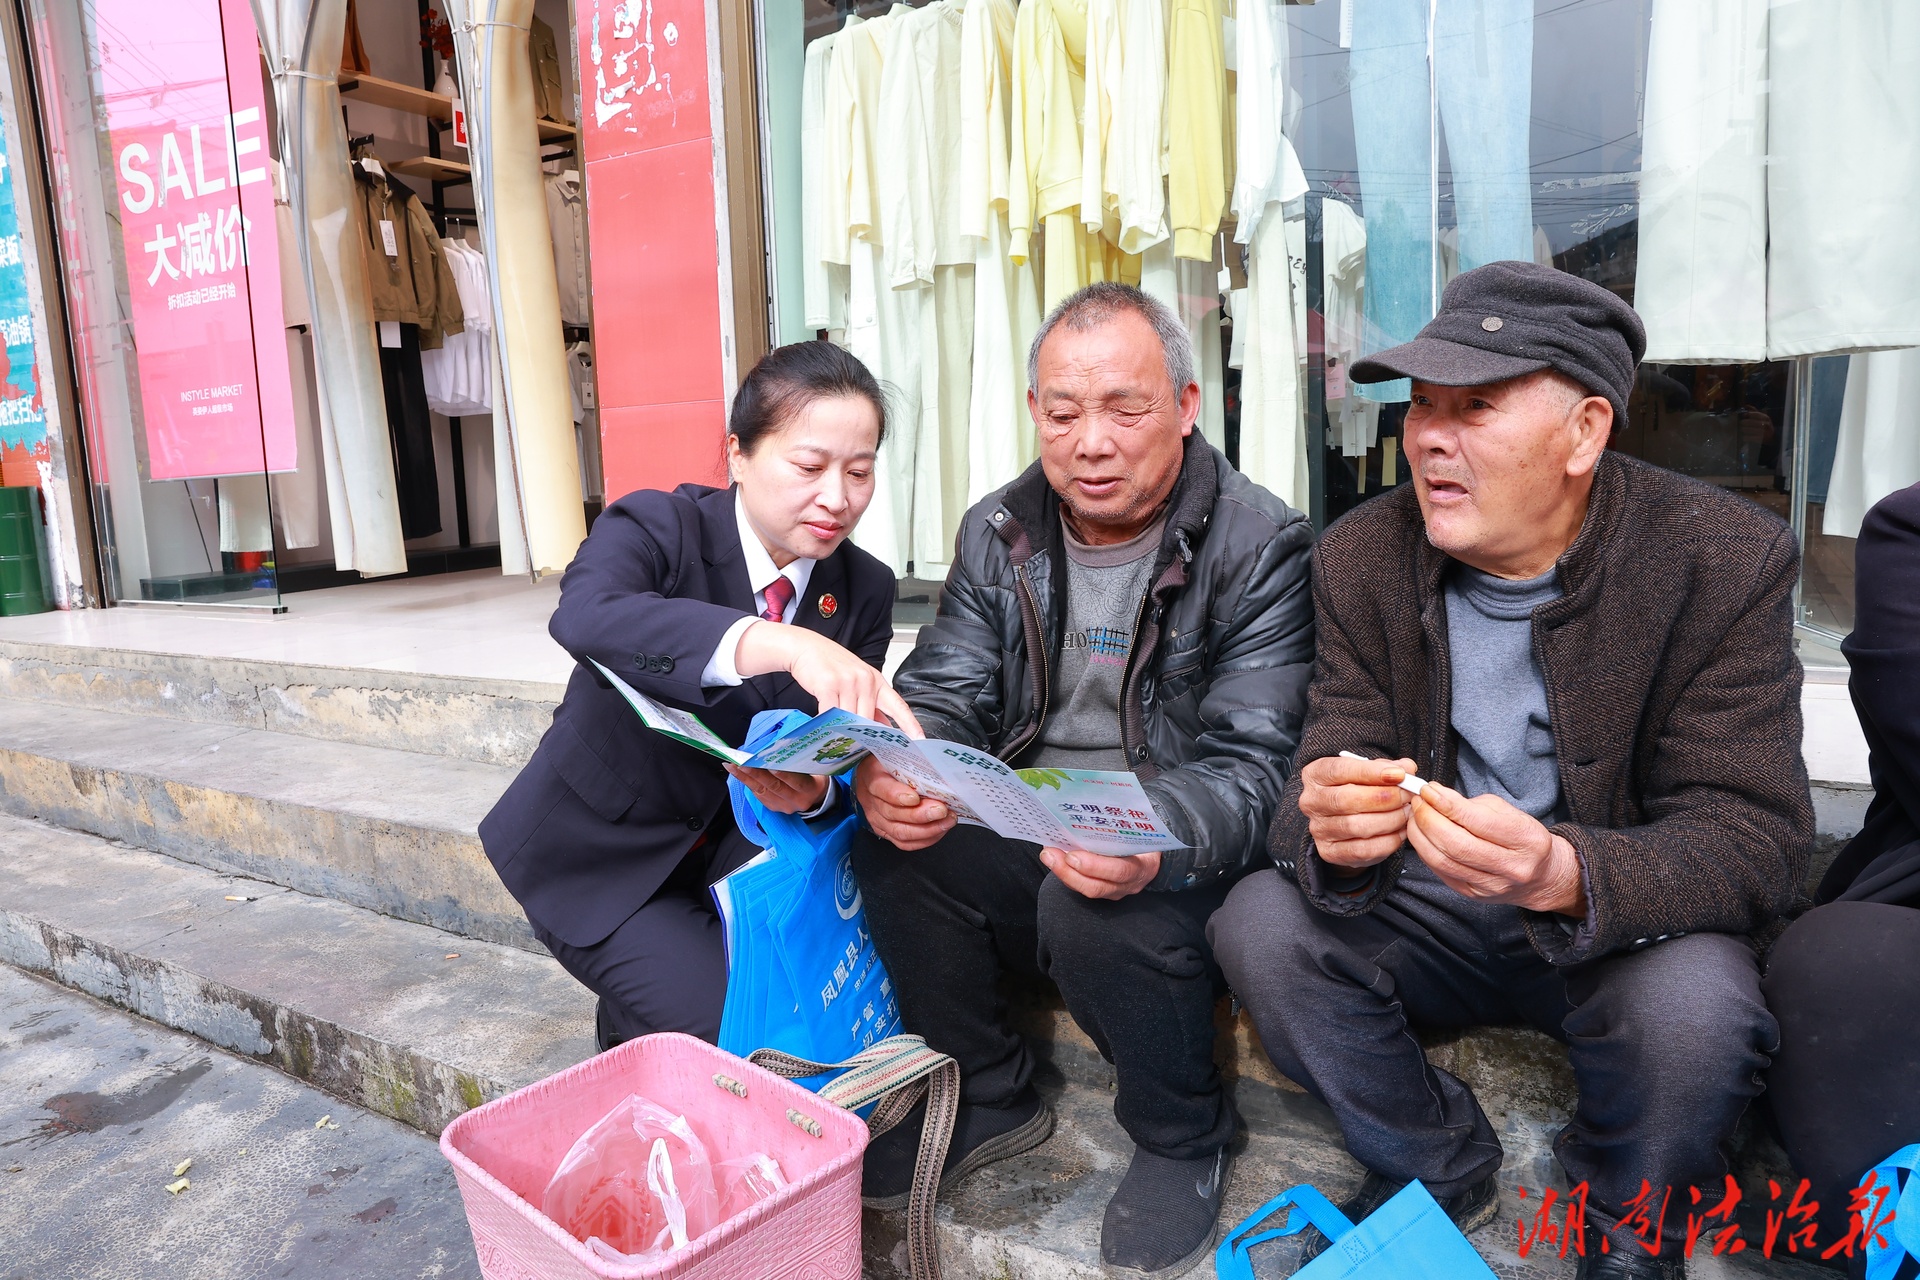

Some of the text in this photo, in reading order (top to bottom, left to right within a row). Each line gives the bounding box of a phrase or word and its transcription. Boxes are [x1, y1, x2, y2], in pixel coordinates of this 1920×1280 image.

[119, 106, 267, 215] SALE
[144, 203, 252, 288] 大减价
[167, 282, 237, 311] 折扣活动已经开始
[180, 384, 243, 403] INSTYLE MARKET
[821, 914, 869, 1012] 凤凰县人
